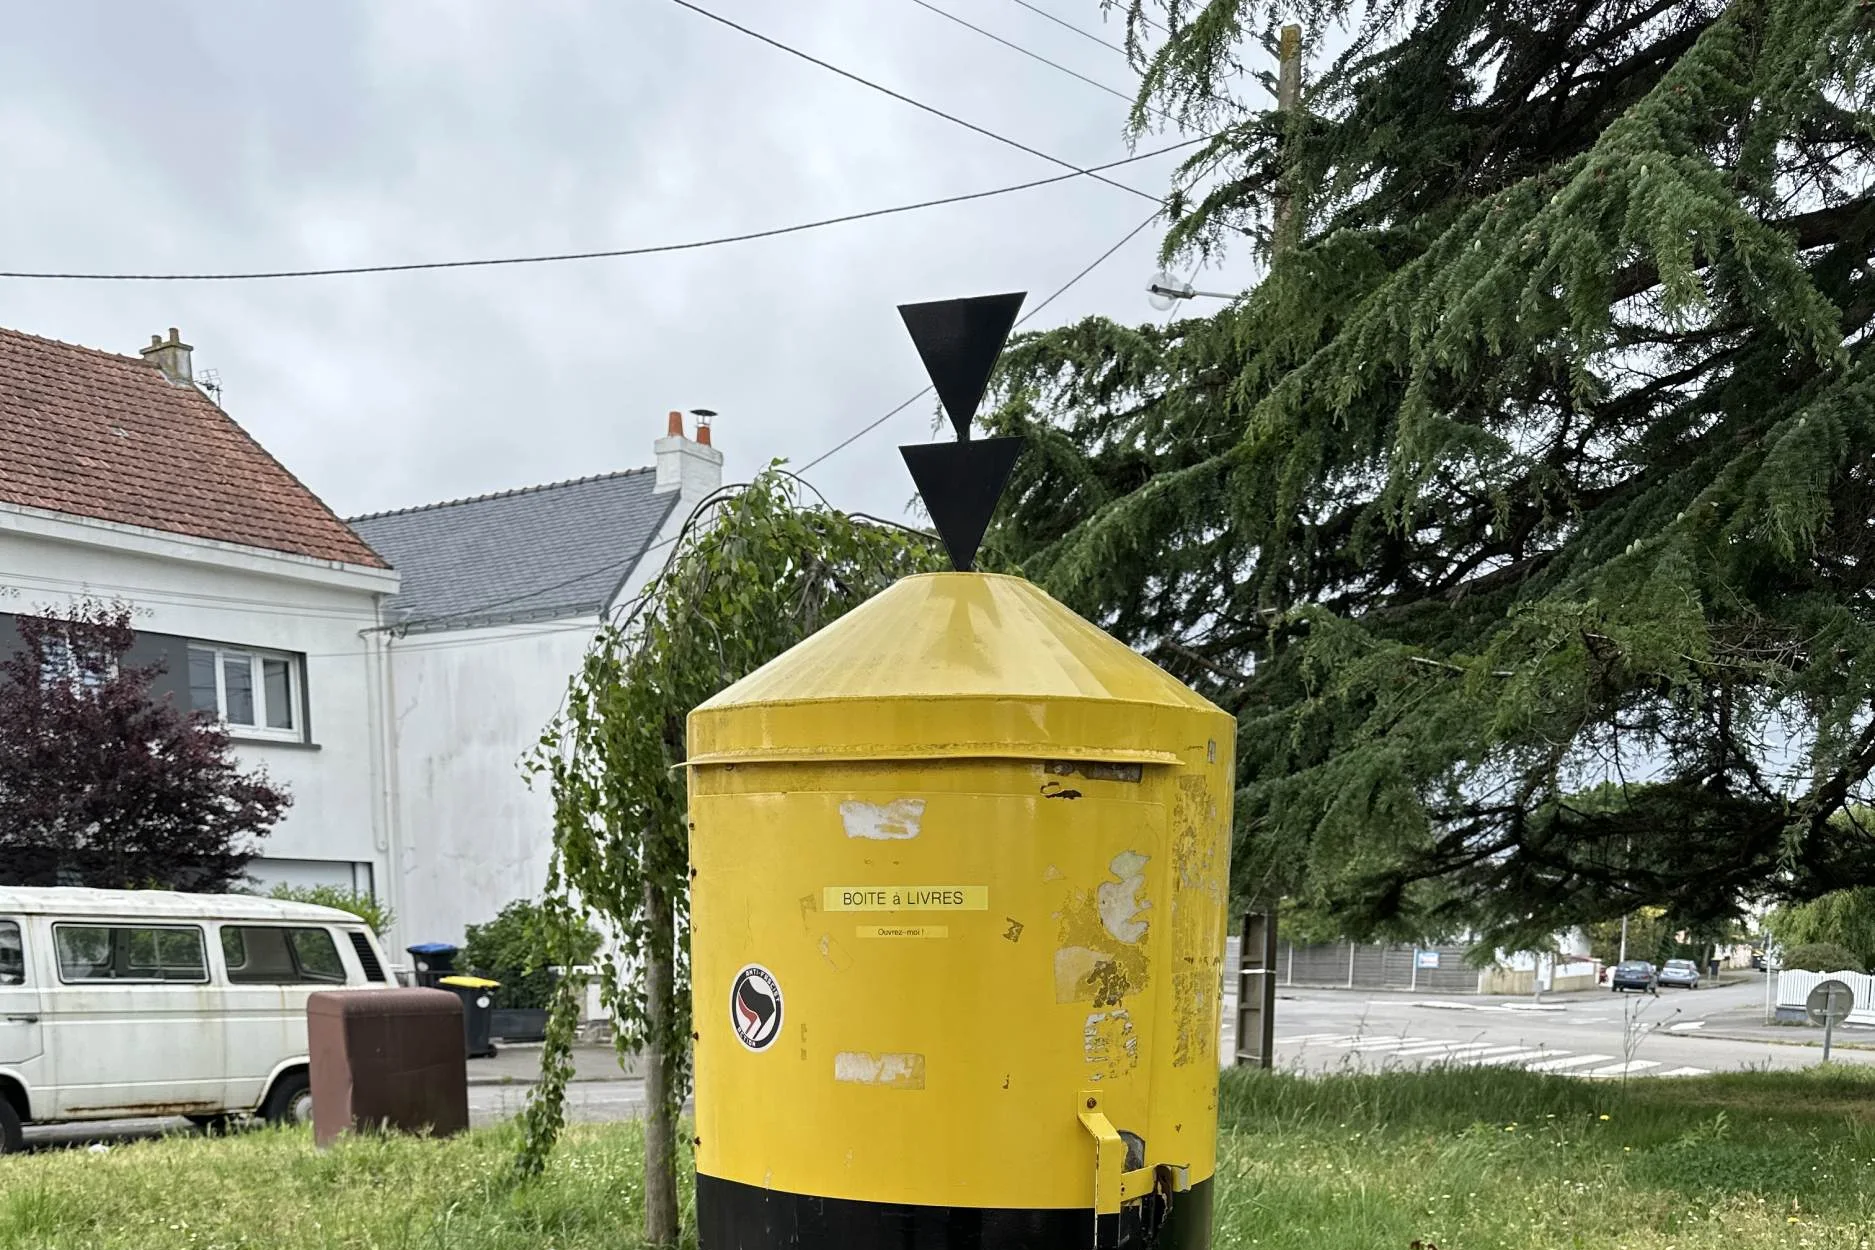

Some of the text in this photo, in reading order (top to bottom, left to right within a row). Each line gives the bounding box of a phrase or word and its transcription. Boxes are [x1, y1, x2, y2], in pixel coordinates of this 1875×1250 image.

[843, 890, 964, 906] BOITE à LIVRES
